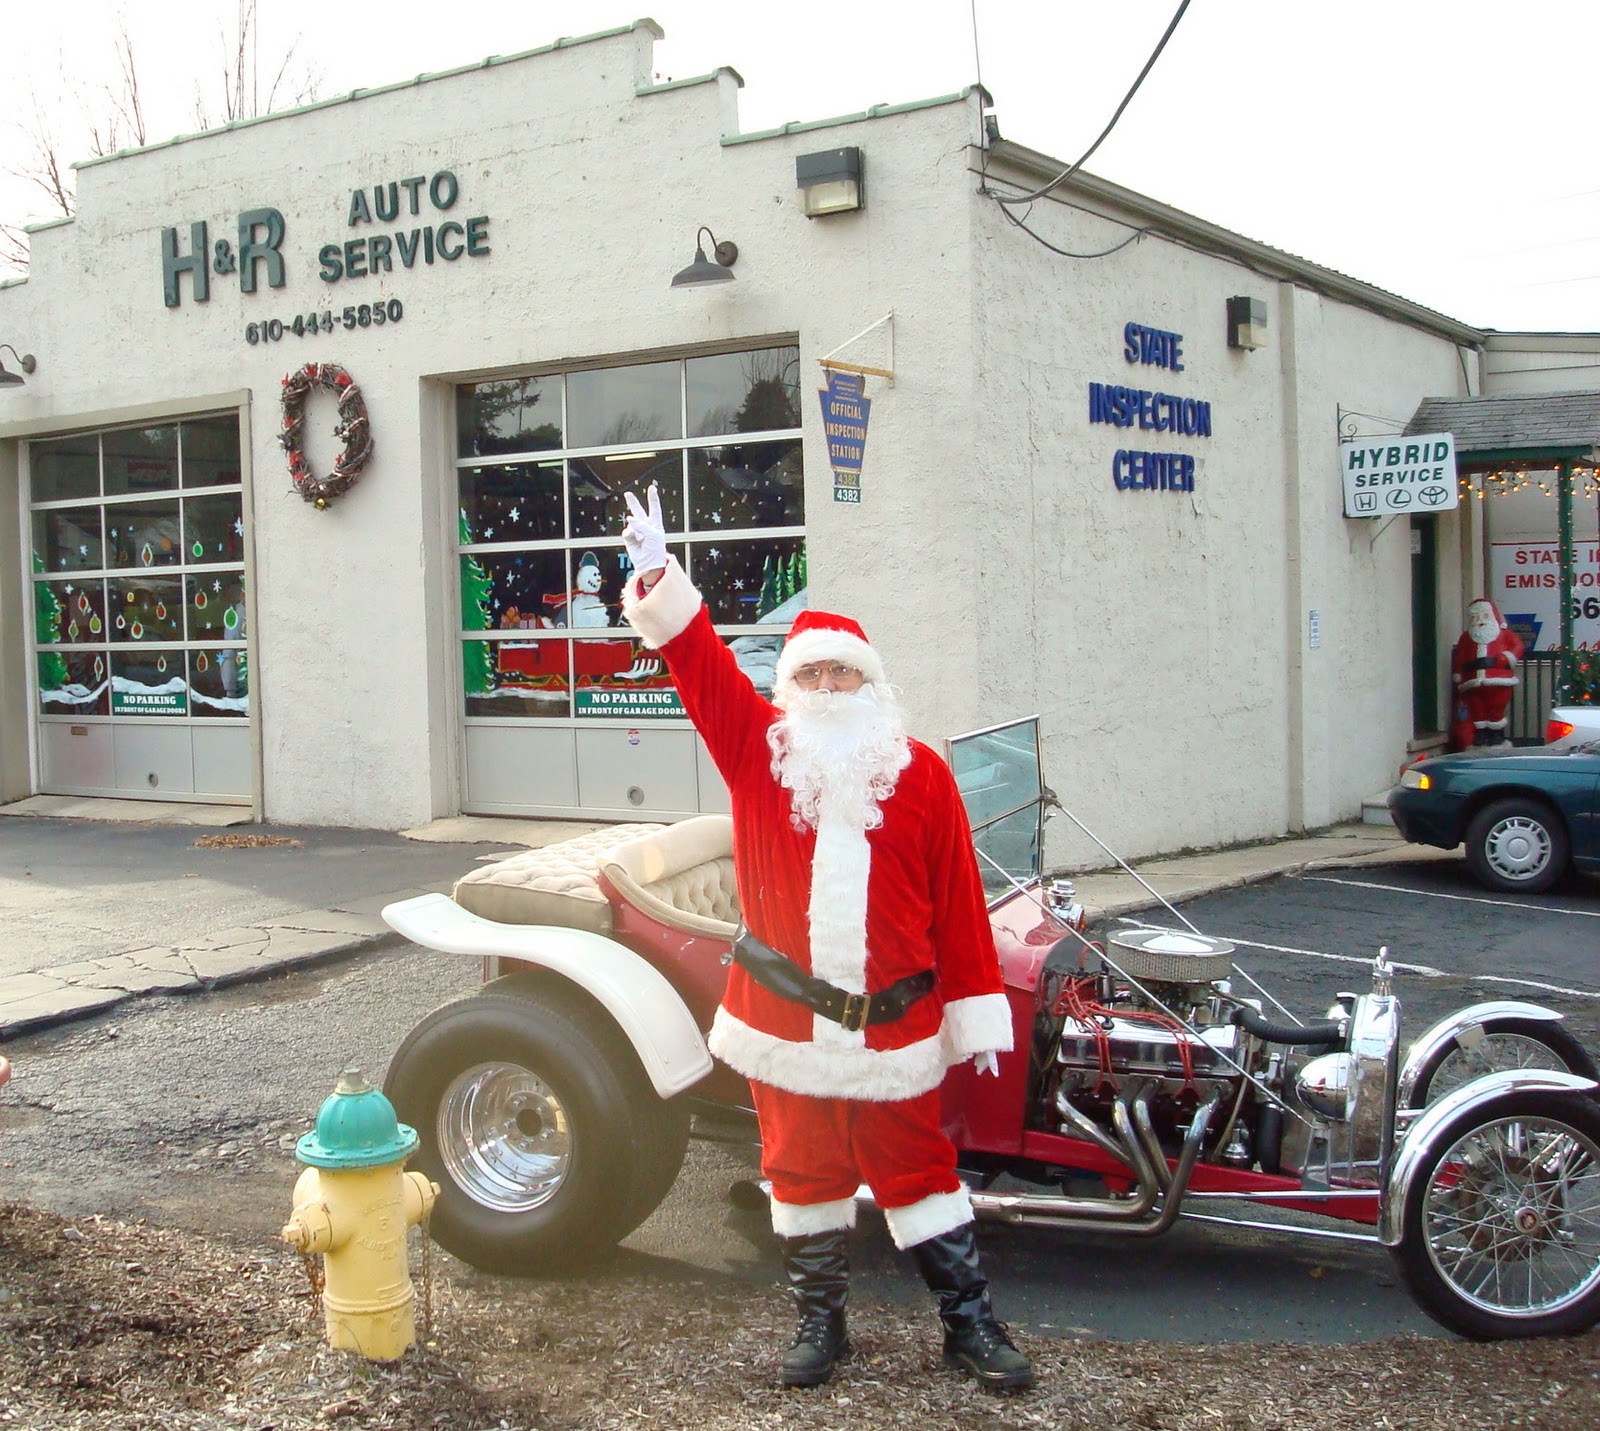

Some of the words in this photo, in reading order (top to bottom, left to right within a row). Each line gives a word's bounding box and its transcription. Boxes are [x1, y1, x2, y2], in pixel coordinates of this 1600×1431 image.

[348, 170, 459, 227] AUTO
[161, 207, 287, 308] H&R
[319, 216, 492, 283] SERVICE
[246, 299, 403, 345] 610-444-5850
[1124, 321, 1184, 372] STATE
[830, 401, 862, 420] OFFICIAL
[1089, 382, 1212, 437] INSPECTION
[826, 422, 866, 440] INSPECTION
[831, 443, 861, 460] STATION
[1348, 441, 1449, 470] HYBRID
[838, 474, 857, 485] 4382
[1113, 449, 1195, 492] CENTER
[1355, 467, 1443, 488] SERVICE
[837, 489, 858, 501] 4382
[123, 695, 136, 704] NO
[136, 695, 177, 705] PARKING
[592, 693, 610, 704] NO
[612, 693, 672, 704] PARKING
[587, 707, 612, 715] FRONT
[625, 707, 657, 715] GARAGE
[658, 707, 687, 715] DOORS
